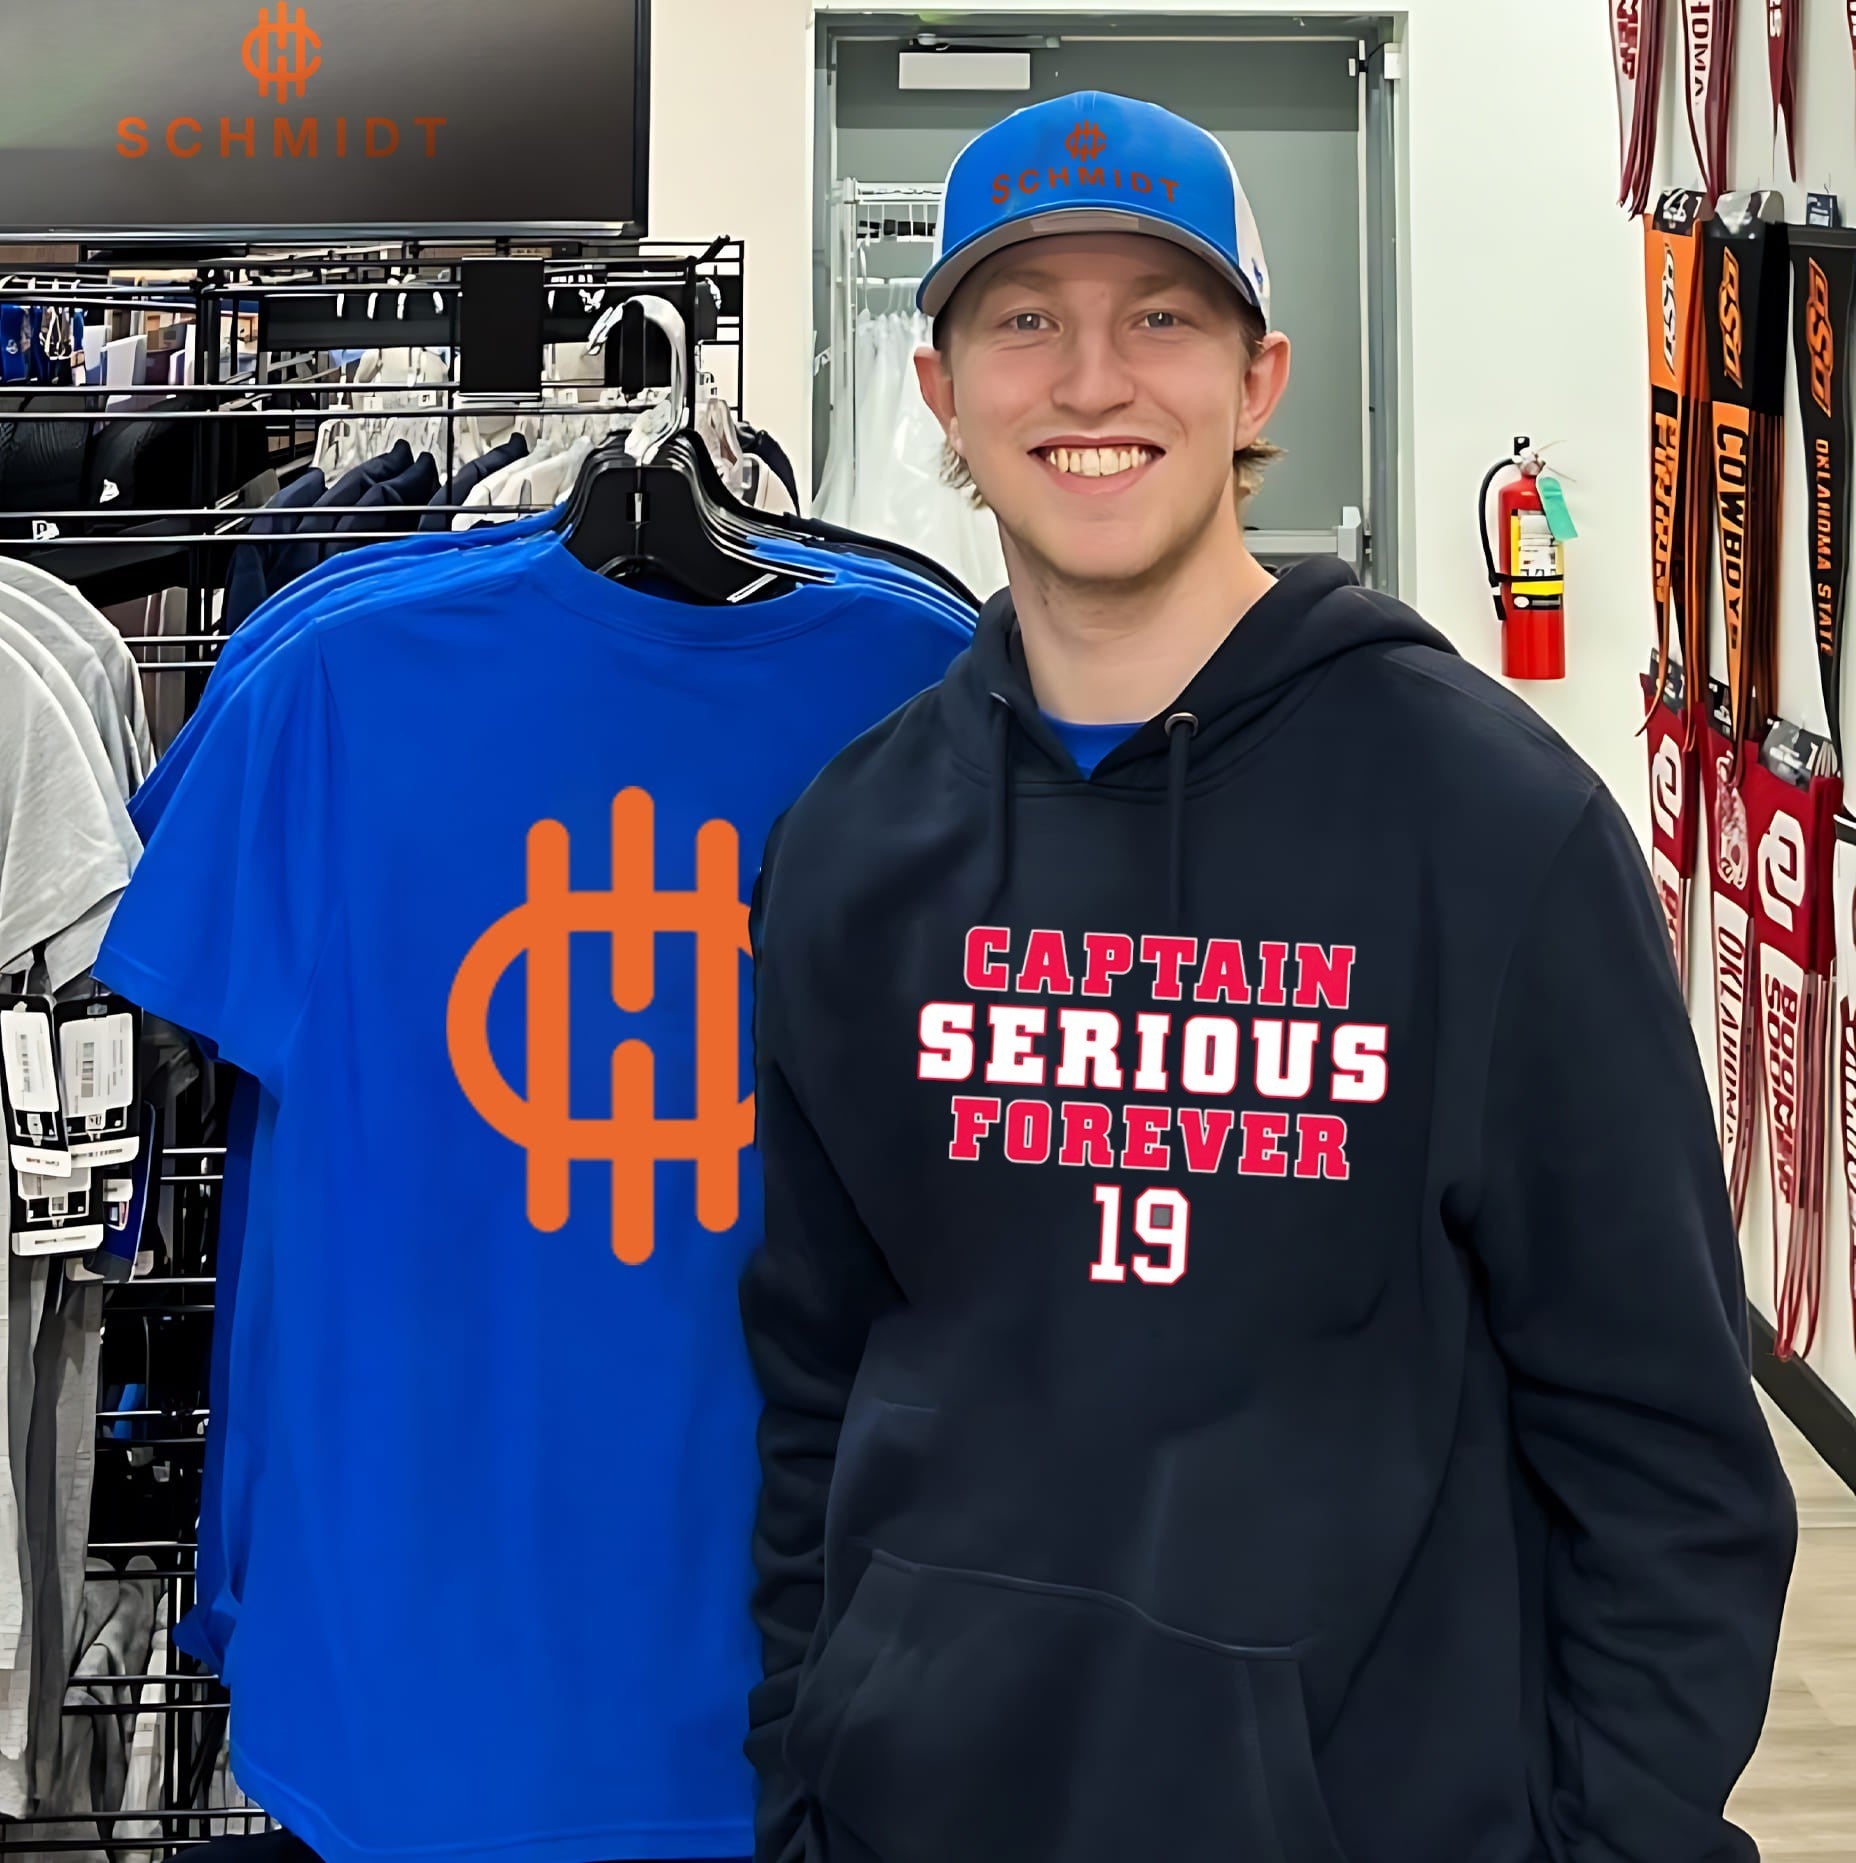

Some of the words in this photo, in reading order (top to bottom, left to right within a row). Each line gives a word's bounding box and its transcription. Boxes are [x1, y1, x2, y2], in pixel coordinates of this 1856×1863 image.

[115, 116, 448, 158] SCHMIDT
[991, 167, 1180, 205] SCHMIDT
[1815, 438, 1832, 570] OKLAHOMA
[1817, 582, 1834, 657] STATE
[963, 925, 1356, 1010] CAPTAIN
[916, 1000, 1389, 1103] SERIOUS
[1718, 926, 1745, 1144] OKLAHOMA
[948, 1095, 1350, 1181] FOREVER
[1089, 1183, 1191, 1285] 19
